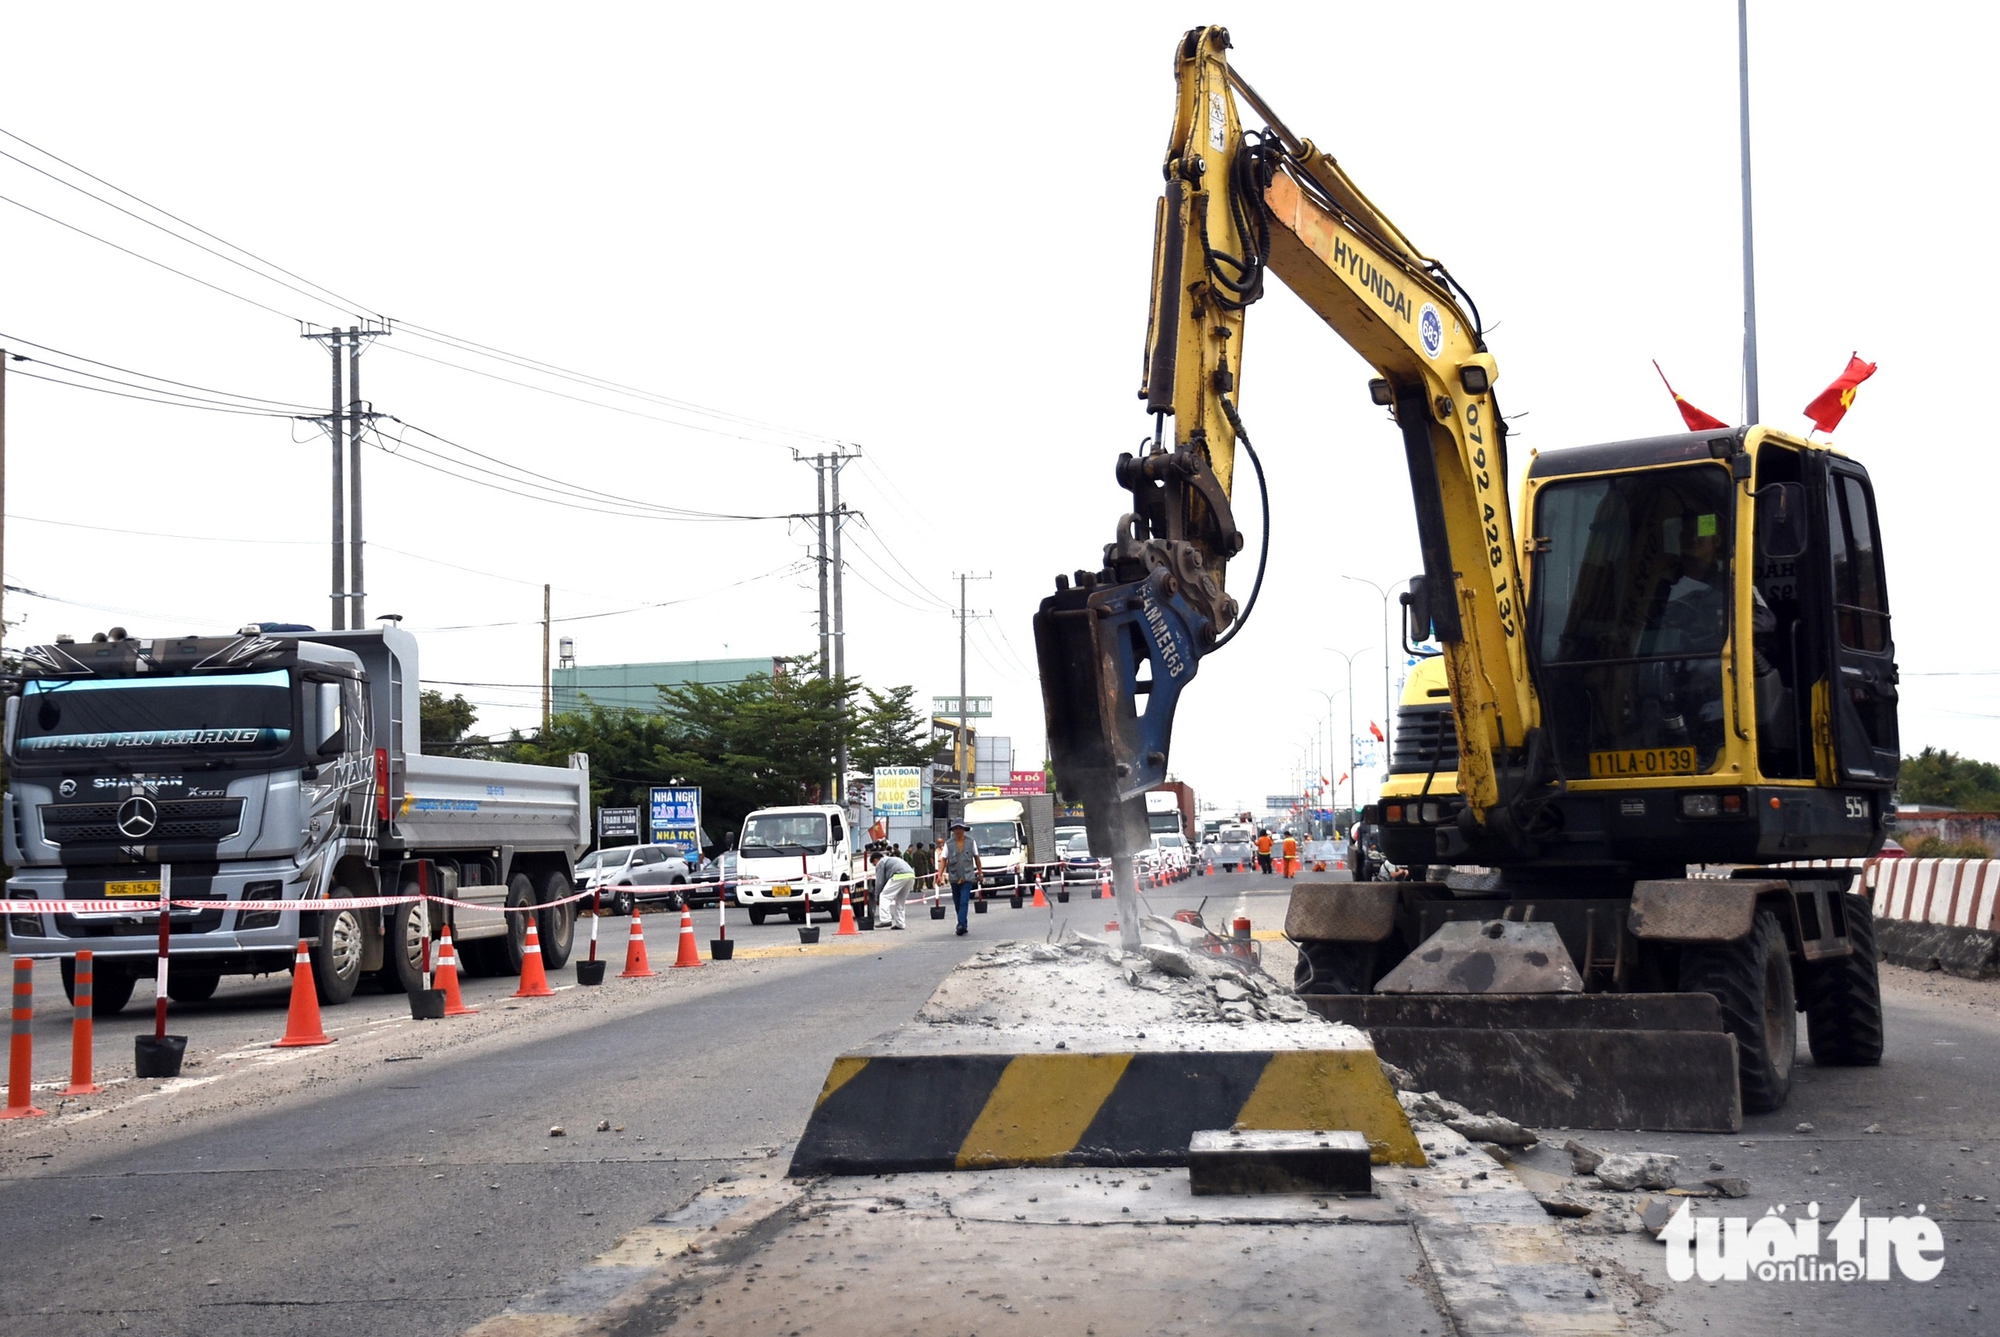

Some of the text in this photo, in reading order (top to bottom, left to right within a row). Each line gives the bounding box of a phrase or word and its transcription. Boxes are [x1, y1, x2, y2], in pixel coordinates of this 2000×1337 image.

[1334, 236, 1412, 324] HYUNDAI
[1422, 320, 1439, 348] 683
[1466, 403, 1515, 640] 0792 428 132
[116, 730, 155, 747] AN
[162, 728, 259, 746] KHANG
[1596, 749, 1692, 775] 11LA-0139
[654, 789, 673, 803] NHÀ
[653, 802, 697, 819] TÂN HẢ
